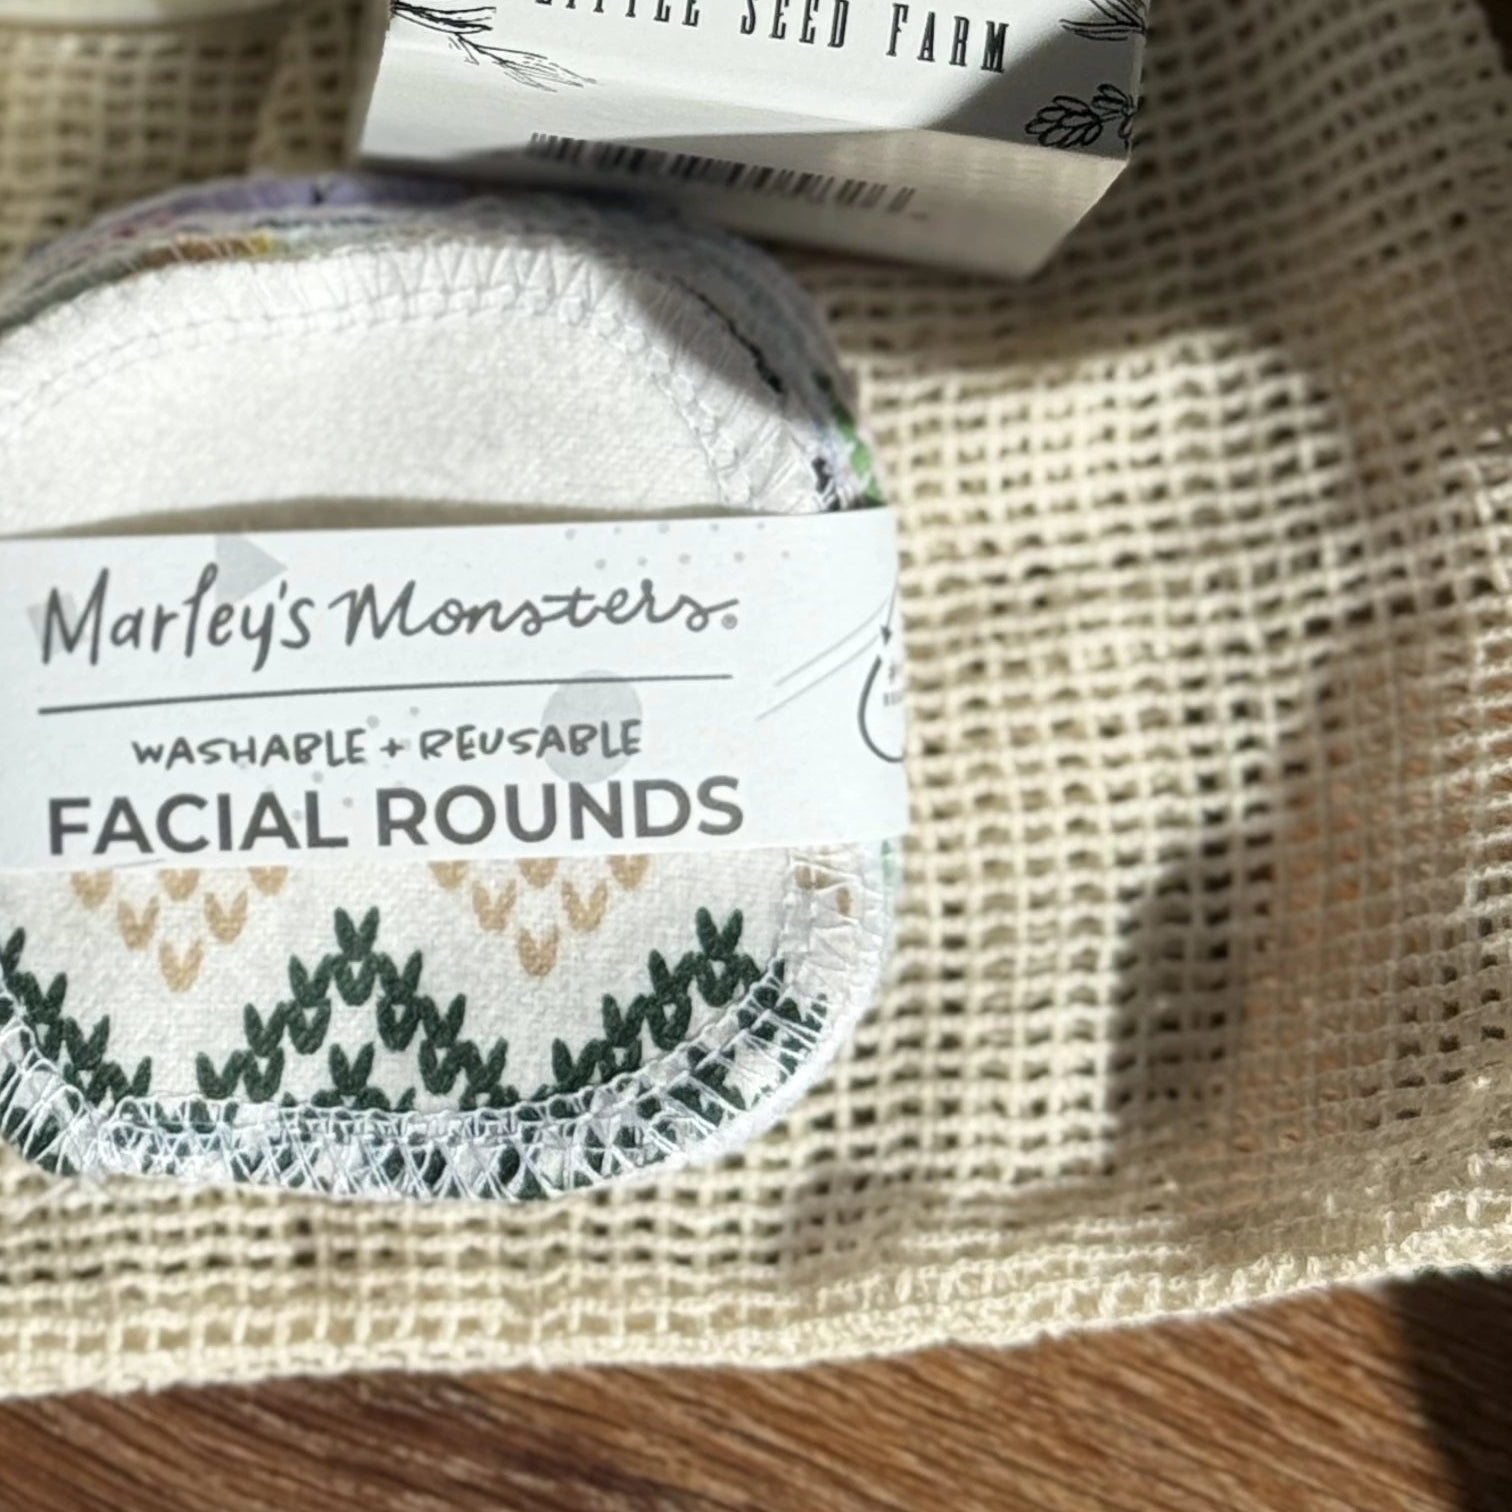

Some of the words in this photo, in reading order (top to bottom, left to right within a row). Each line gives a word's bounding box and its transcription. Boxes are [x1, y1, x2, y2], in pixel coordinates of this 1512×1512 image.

[886, 3, 1009, 74] FARM
[42, 562, 314, 672] Marley's
[132, 728, 366, 770] WASHABLE
[420, 719, 641, 761] REUSABLE
[48, 790, 348, 856] FACIAL
[376, 775, 744, 847] ROUNDS
